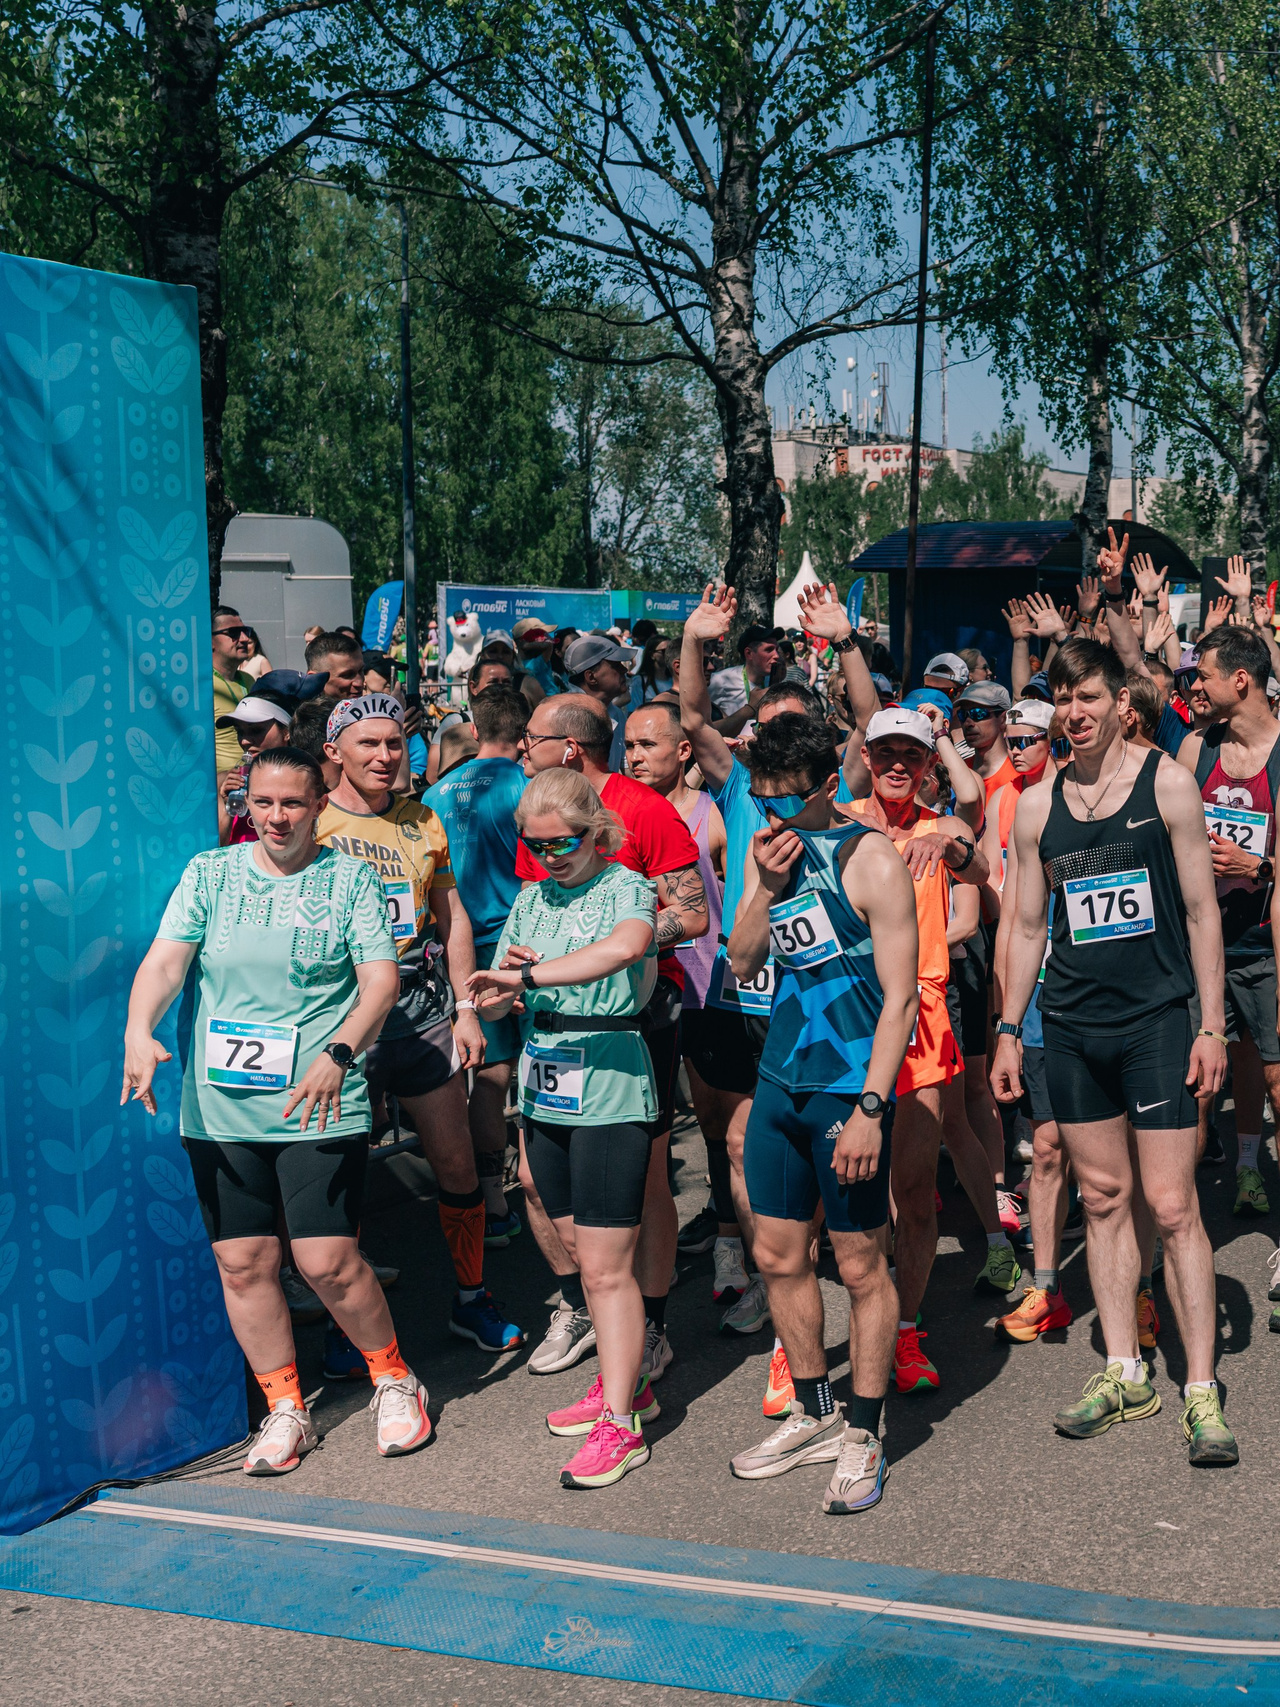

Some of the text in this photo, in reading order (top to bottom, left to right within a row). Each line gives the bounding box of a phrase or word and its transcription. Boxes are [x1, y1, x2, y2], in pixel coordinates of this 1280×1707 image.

[350, 698, 400, 721] DIIKE
[331, 835, 403, 863] NEMDA
[1211, 821, 1254, 850] 132
[1080, 888, 1140, 925] 176
[770, 917, 816, 953] 130
[1113, 922, 1146, 933] АЛЕКСАНДР
[802, 946, 827, 960] САВЕЛИЙ
[226, 1038, 264, 1070] 72
[532, 1062, 558, 1092] 15
